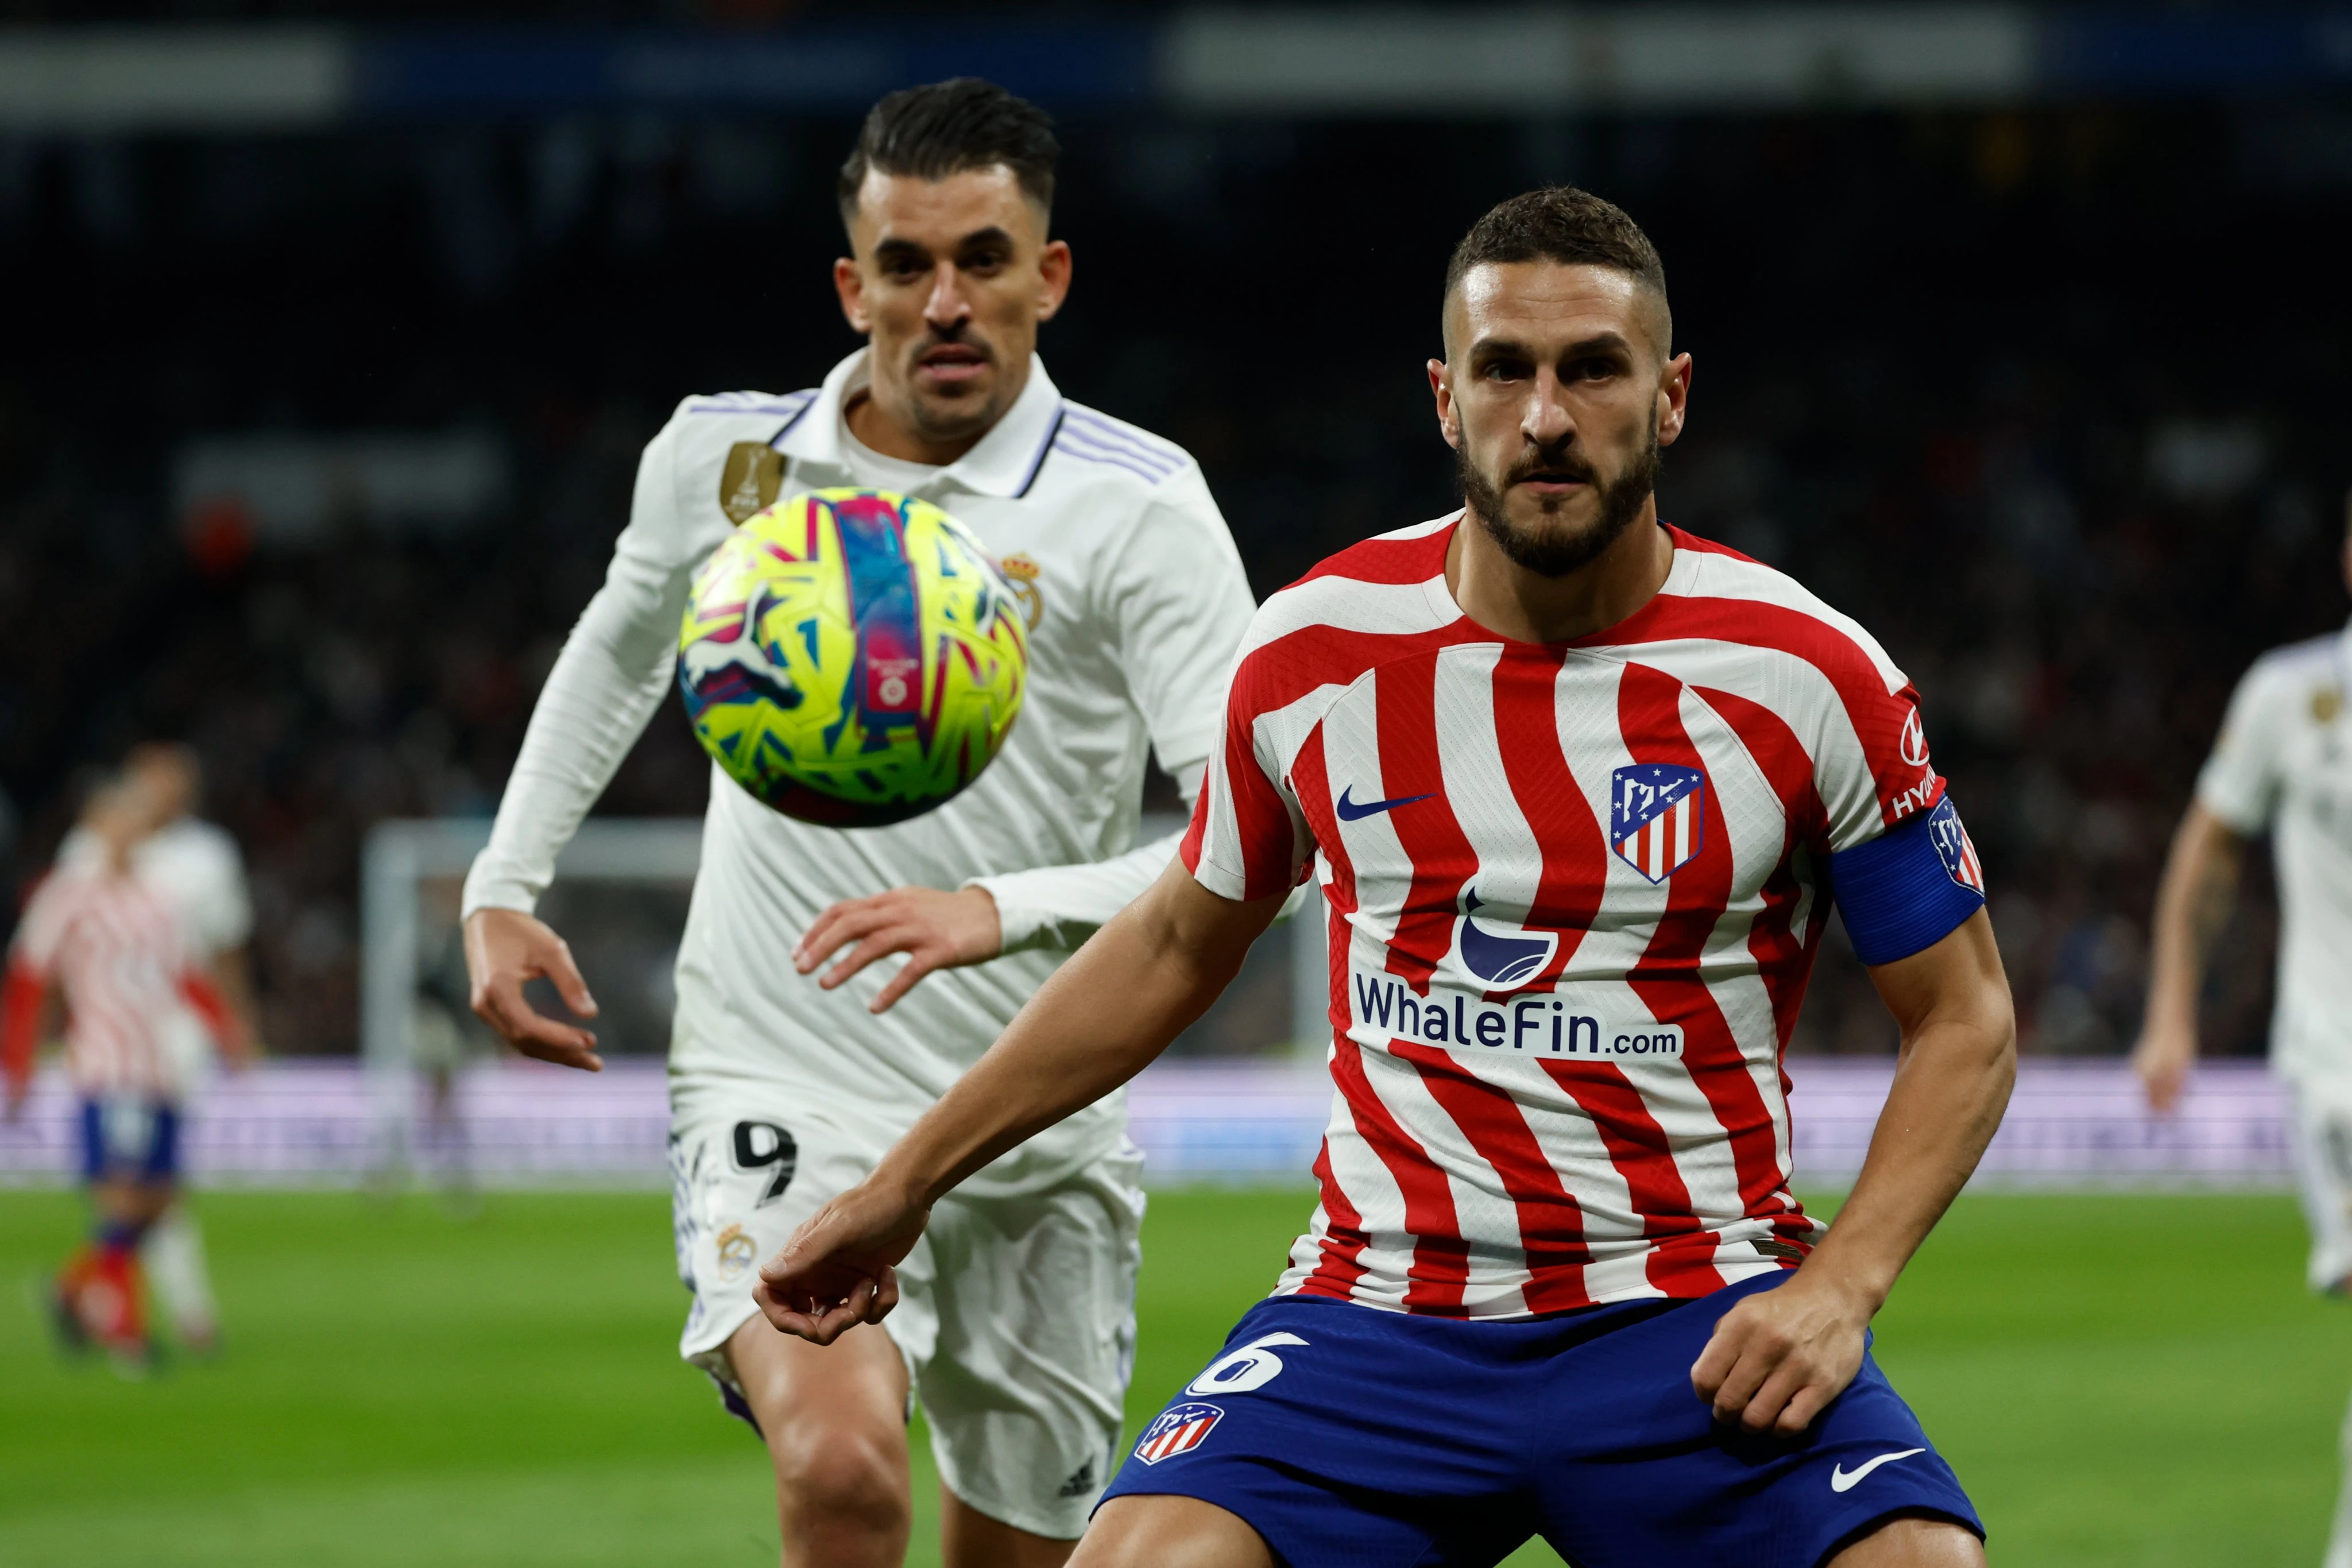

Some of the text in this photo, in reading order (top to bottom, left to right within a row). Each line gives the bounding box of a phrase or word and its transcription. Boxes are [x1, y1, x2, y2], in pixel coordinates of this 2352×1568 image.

[1356, 973, 1677, 1054] WhaleFin.com
[733, 1120, 798, 1209] 9
[1185, 1331, 1311, 1396] 6
